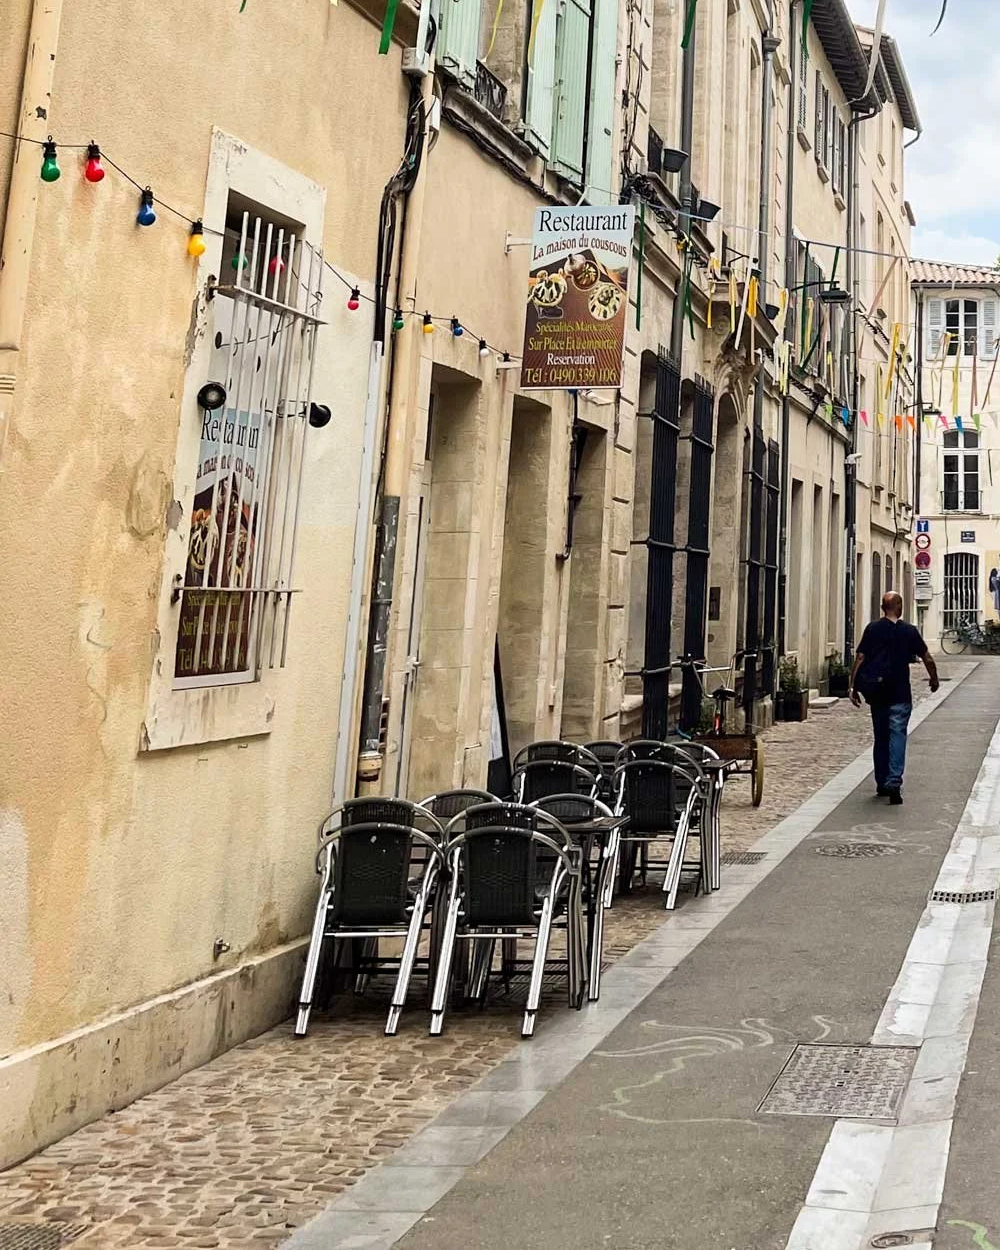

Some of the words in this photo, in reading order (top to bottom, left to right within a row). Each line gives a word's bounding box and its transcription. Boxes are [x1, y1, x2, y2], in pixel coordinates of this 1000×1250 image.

[539, 210, 628, 232] Restaurant
[533, 245, 544, 261] La
[546, 236, 577, 255] maison
[579, 233, 589, 248] du
[591, 237, 627, 257] couscous
[528, 337, 543, 351] Sur
[543, 336, 565, 351] Place
[549, 367, 575, 383] 0490
